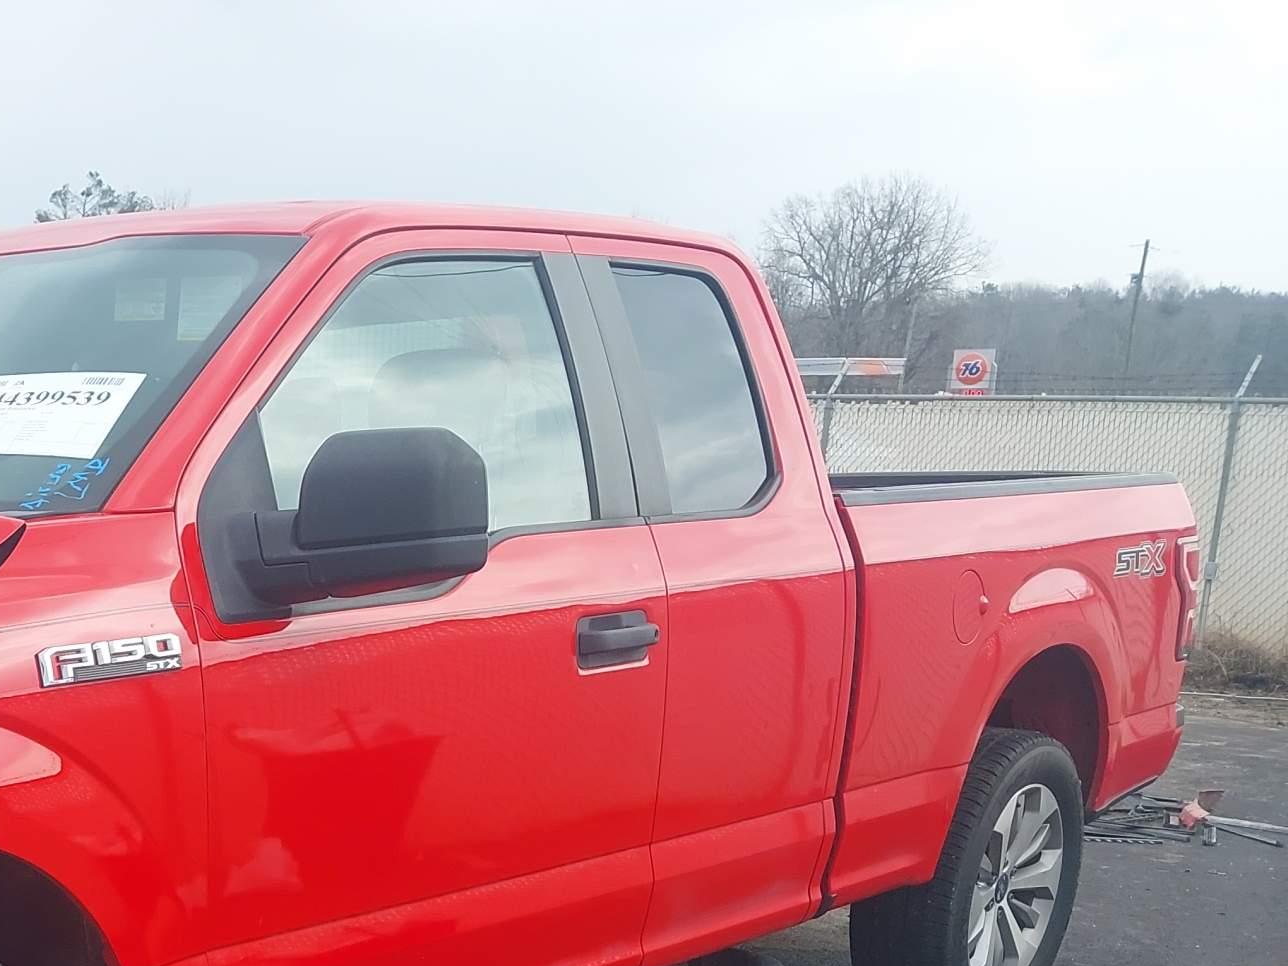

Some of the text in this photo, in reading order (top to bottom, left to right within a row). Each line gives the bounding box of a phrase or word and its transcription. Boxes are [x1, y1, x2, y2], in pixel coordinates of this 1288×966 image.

[959, 360, 982, 378] 76
[1113, 539, 1167, 577] STX
[146, 657, 181, 671] STX
